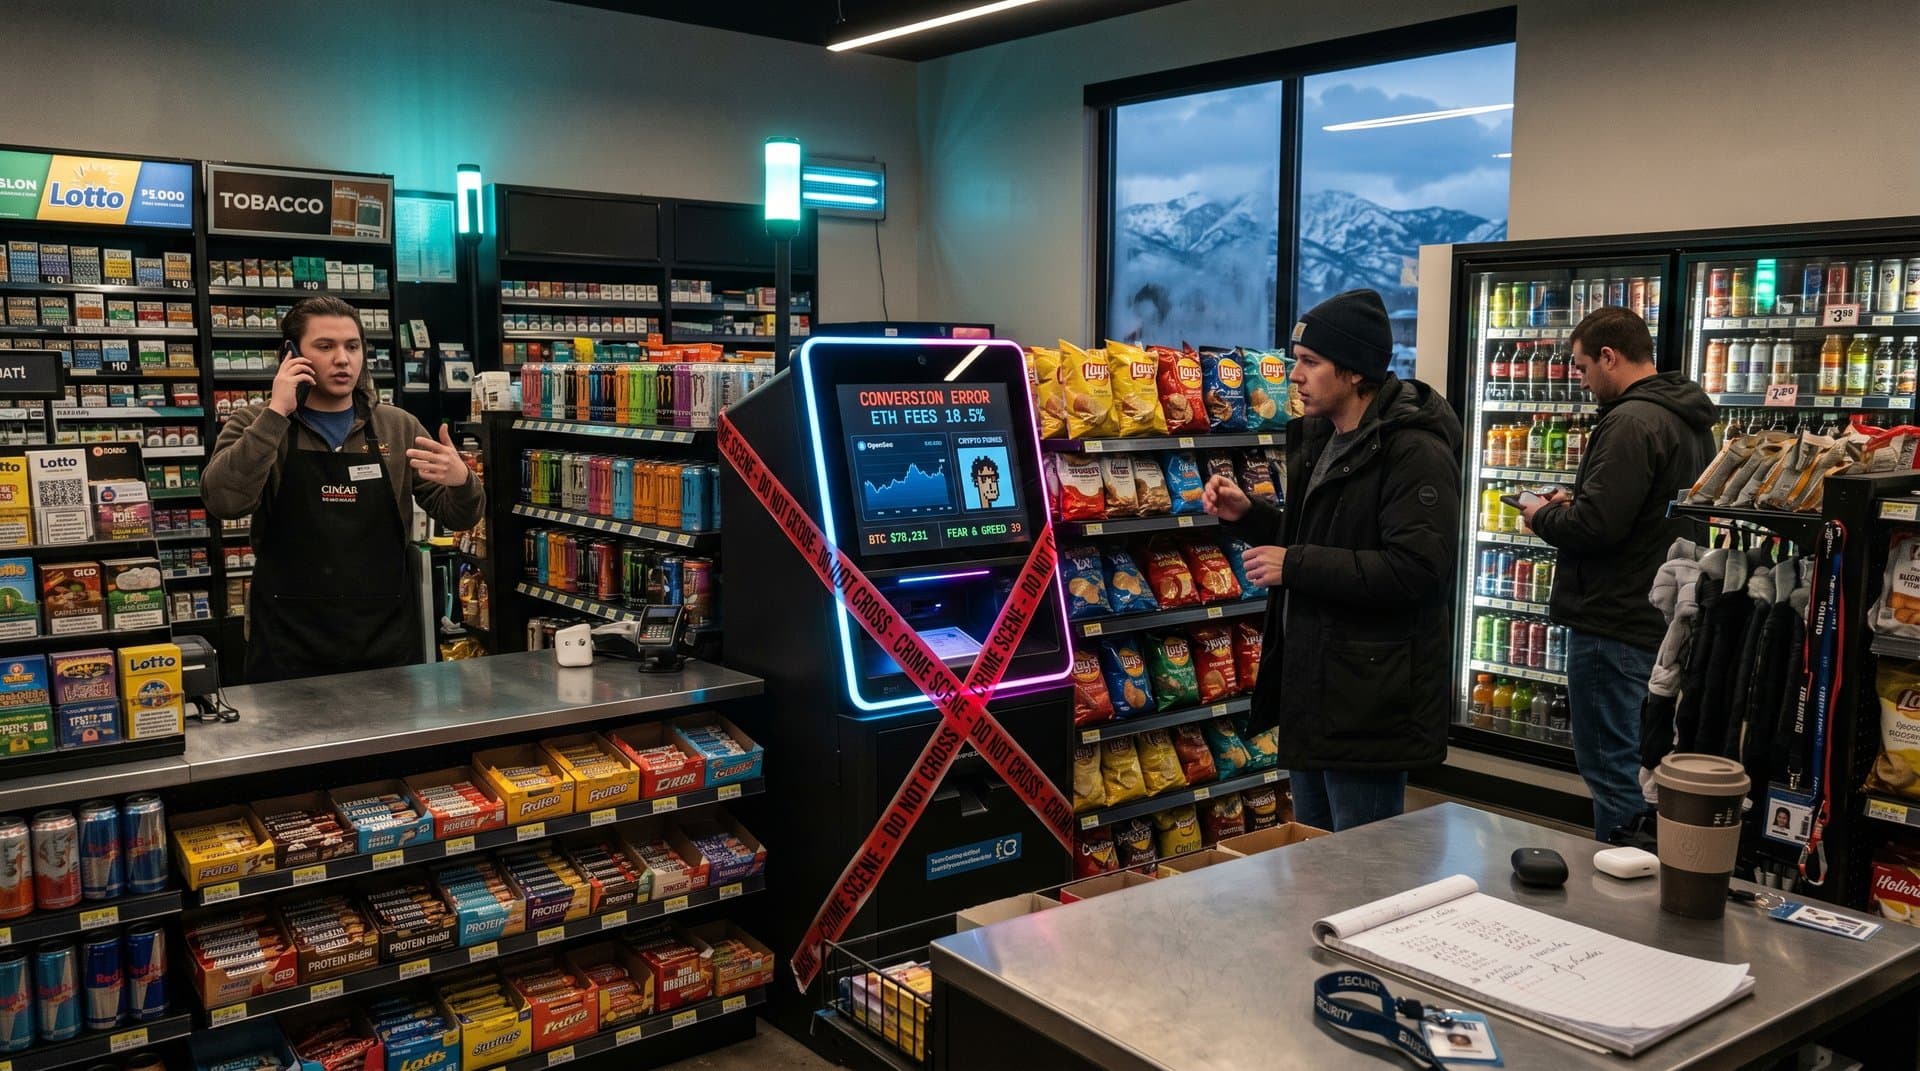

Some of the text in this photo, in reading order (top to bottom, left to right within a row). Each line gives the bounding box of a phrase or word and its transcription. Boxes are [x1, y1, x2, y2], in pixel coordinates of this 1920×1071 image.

[50, 181, 125, 209] Lotto
[220, 191, 324, 215] TOBACCO
[860, 390, 990, 406] CONVERSION ERROR
[871, 408, 985, 425] ETH FEES 18.5%
[40, 458, 77, 469] Lotto
[947, 526, 969, 538] FEAR
[981, 524, 1007, 535] GREED
[1010, 522, 1022, 533] 39
[868, 534, 887, 545] BTC
[730, 438, 756, 473] SCENE
[757, 475, 770, 498] DO
[770, 485, 788, 511] NOT
[817, 544, 833, 570] DO
[851, 586, 893, 632] CROSS
[893, 633, 931, 682] CRIME
[928, 670, 969, 722] SCENE
[971, 718, 992, 744] DO
[990, 736, 1012, 766] NOT
[1007, 757, 1044, 798] CROSS
[130, 655, 176, 672] Lotto
[817, 893, 851, 941] CRIME
[842, 850, 885, 901] SCENE
[883, 813, 906, 839] DO
[898, 780, 928, 818] NOT
[919, 726, 960, 781] CROSS
[969, 648, 1000, 699] CRIME
[992, 604, 1027, 651] SCENE
[1022, 577, 1039, 600] DO
[1031, 549, 1054, 580] NOT
[389, 936, 425, 953] PROTEIN
[308, 955, 347, 972] PROTEIN
